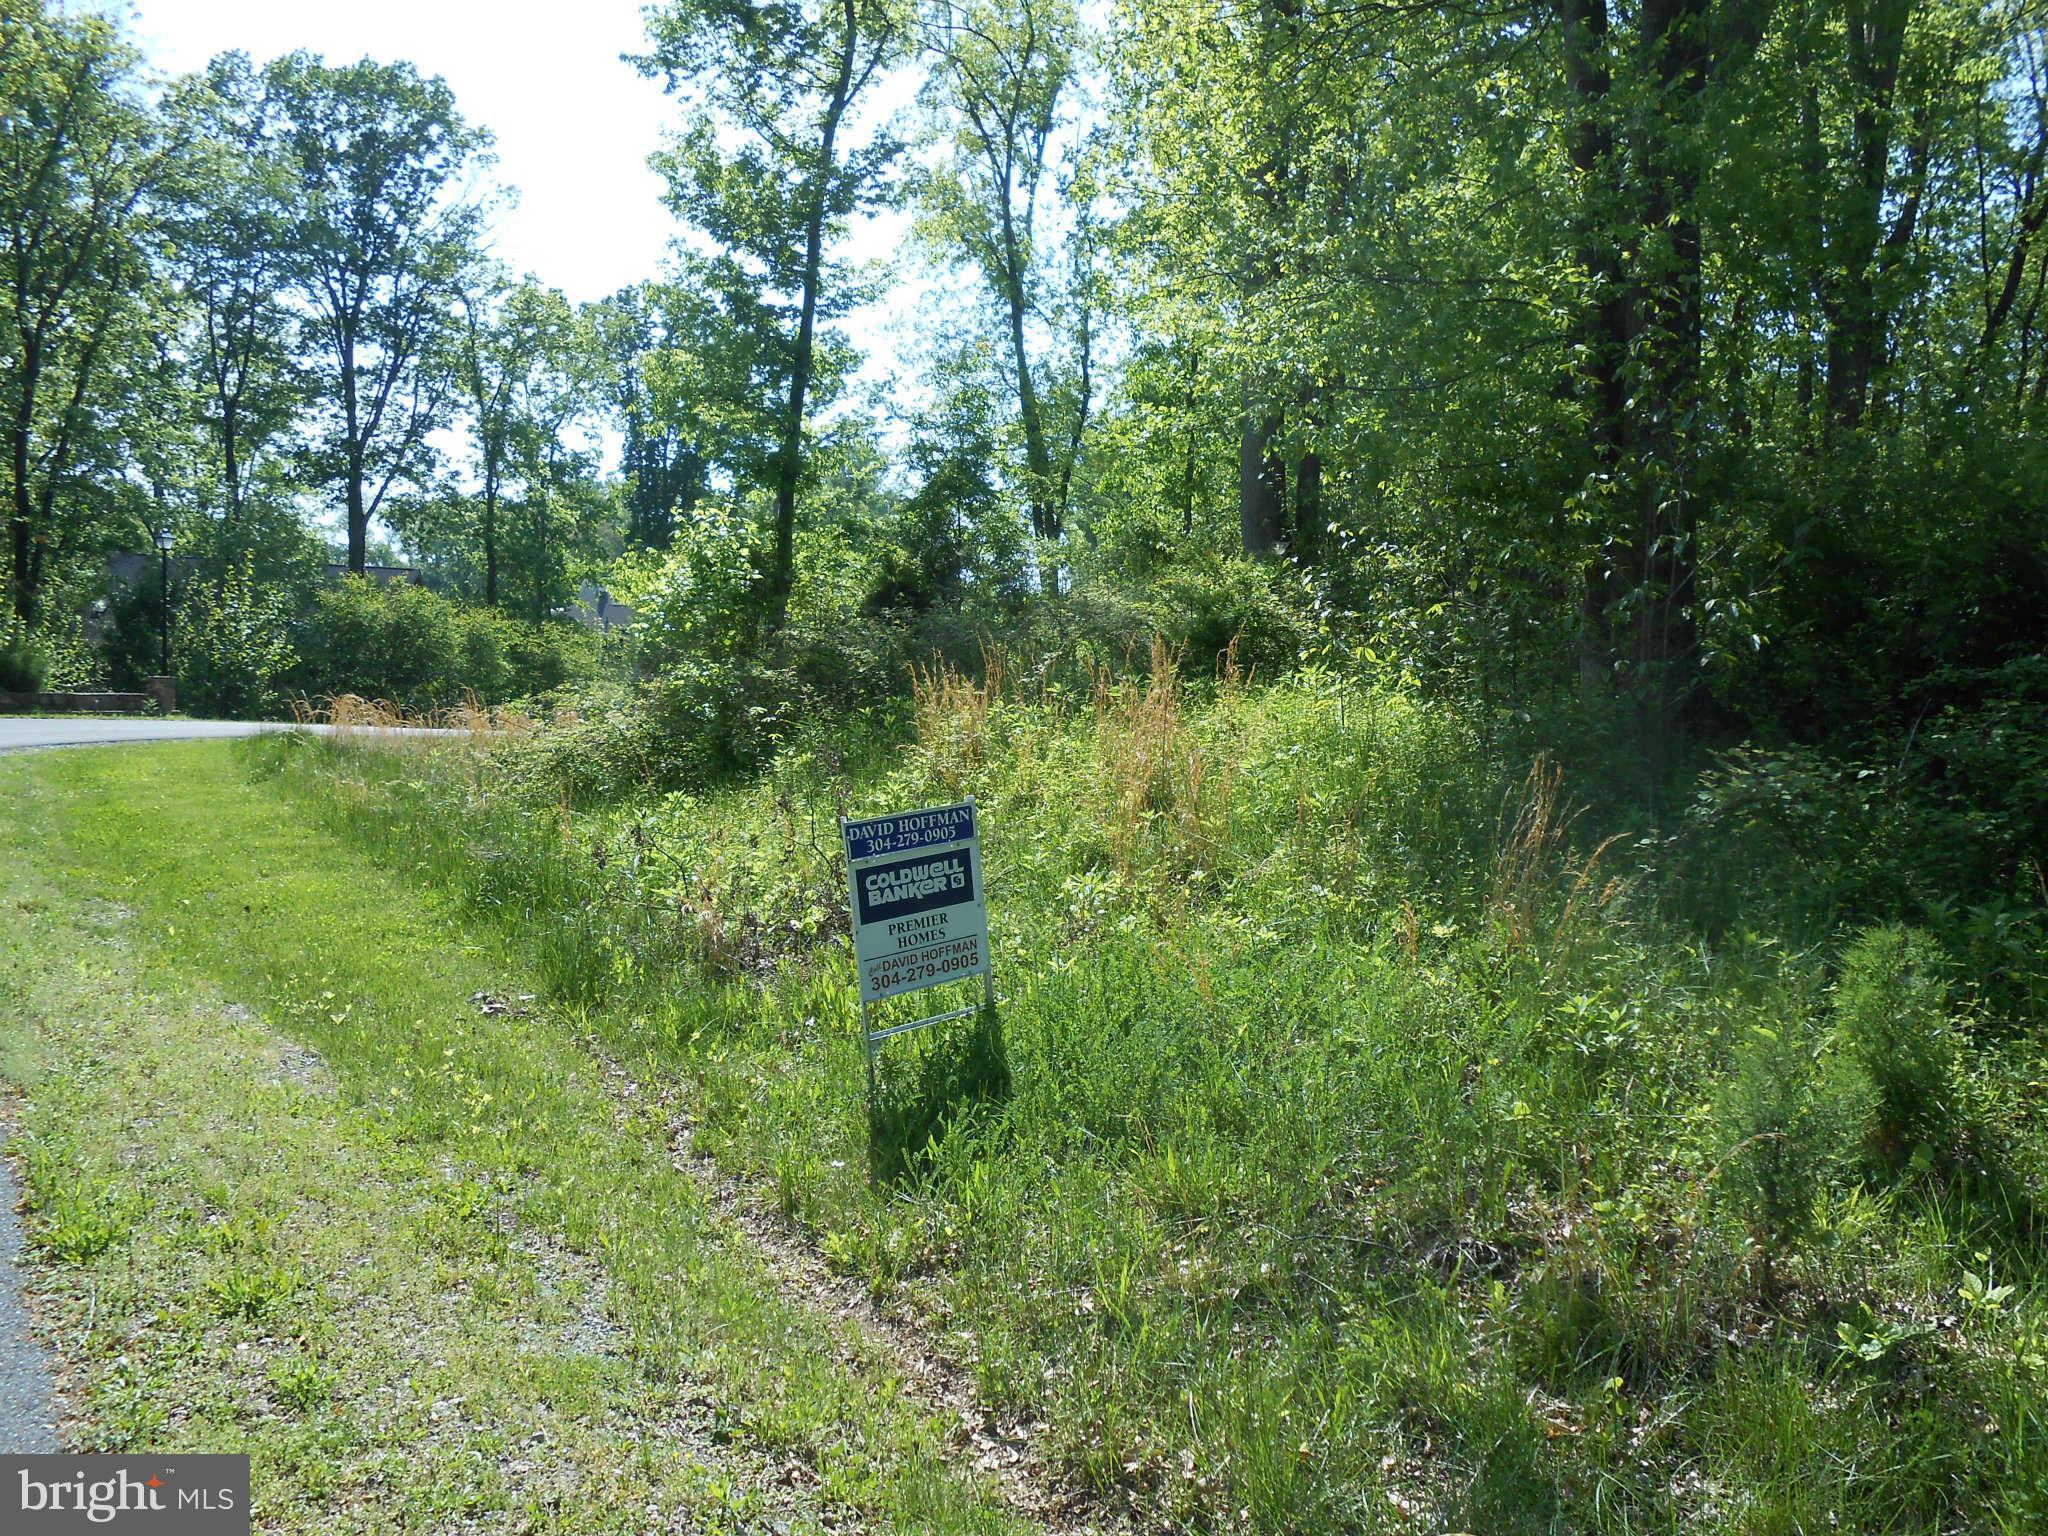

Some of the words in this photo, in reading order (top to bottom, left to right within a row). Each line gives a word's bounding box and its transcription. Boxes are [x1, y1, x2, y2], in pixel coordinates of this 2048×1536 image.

[849, 822, 894, 841] DAVID
[899, 809, 971, 833] HOFFMAN
[866, 826, 956, 853] 304-279-0905
[888, 912, 949, 936] PREMIER
[898, 928, 946, 948] HOMES
[882, 953, 918, 971] DAVID
[921, 939, 978, 965] HOFFMAN
[871, 952, 979, 991] 304-279-0905
